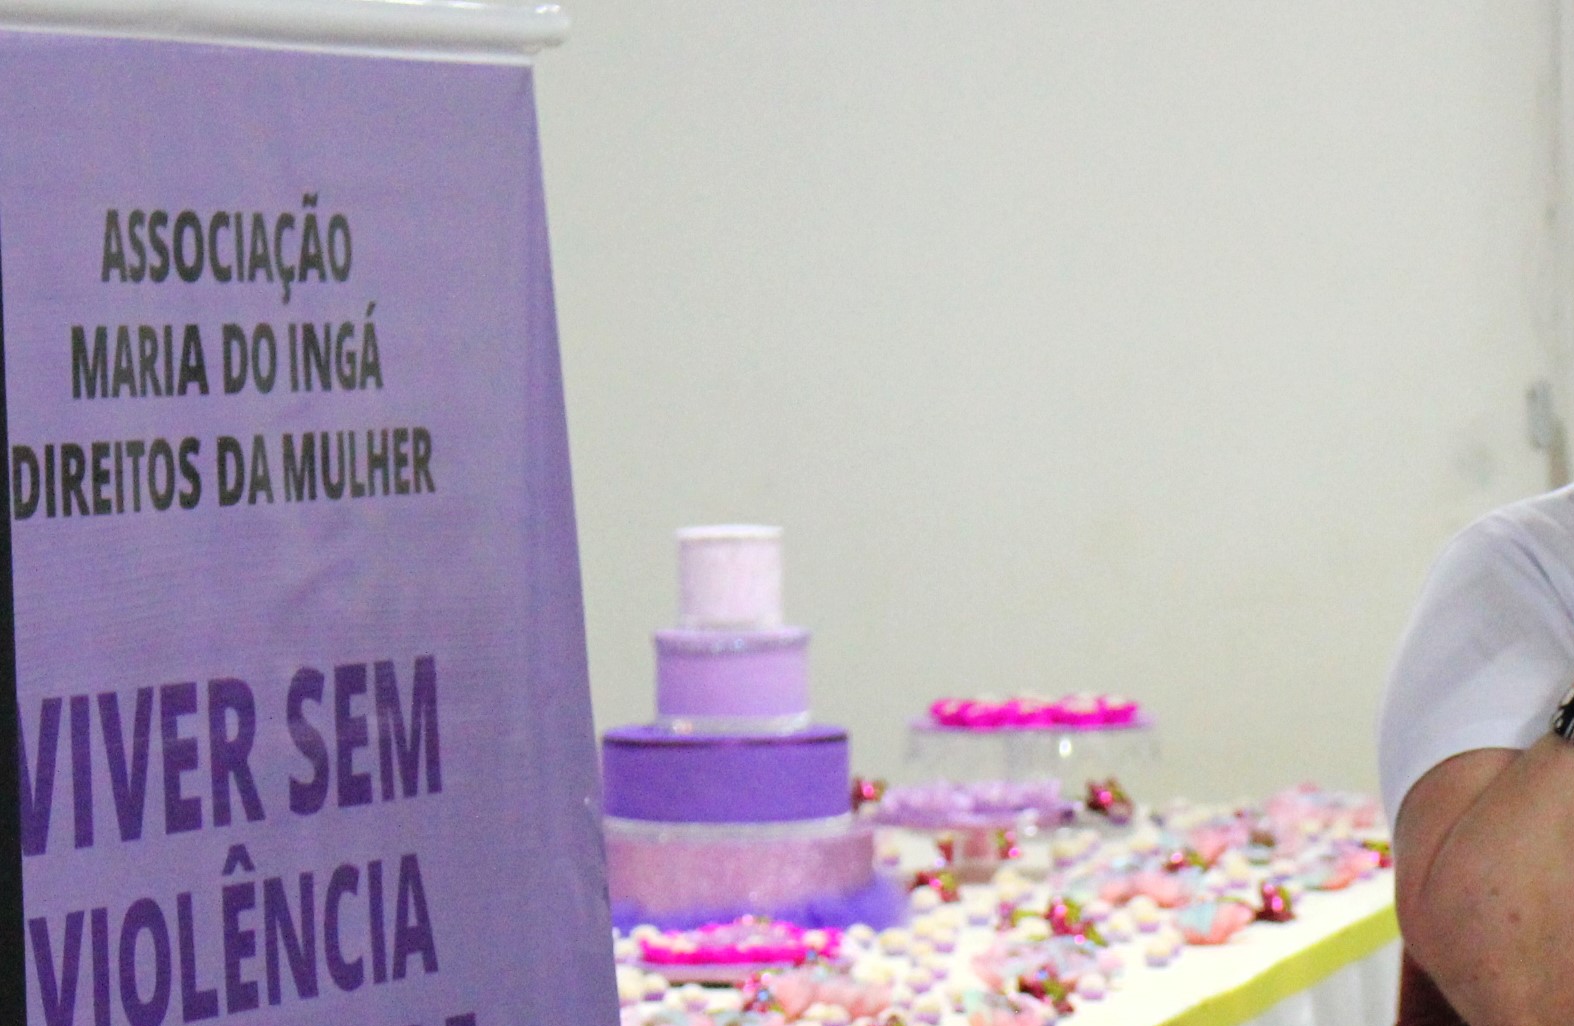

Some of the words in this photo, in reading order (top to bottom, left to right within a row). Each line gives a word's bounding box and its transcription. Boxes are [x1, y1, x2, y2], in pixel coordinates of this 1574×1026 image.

[101, 194, 353, 304] ASSOCIAÇÃO
[71, 323, 209, 399] MARIA
[221, 321, 277, 395] DO
[288, 303, 384, 393] INGÁ
[11, 438, 202, 521] DIREITOS
[217, 434, 274, 507] DA
[281, 426, 437, 502] MULHER
[17, 677, 266, 857] VIVER
[286, 655, 443, 816] SEM
